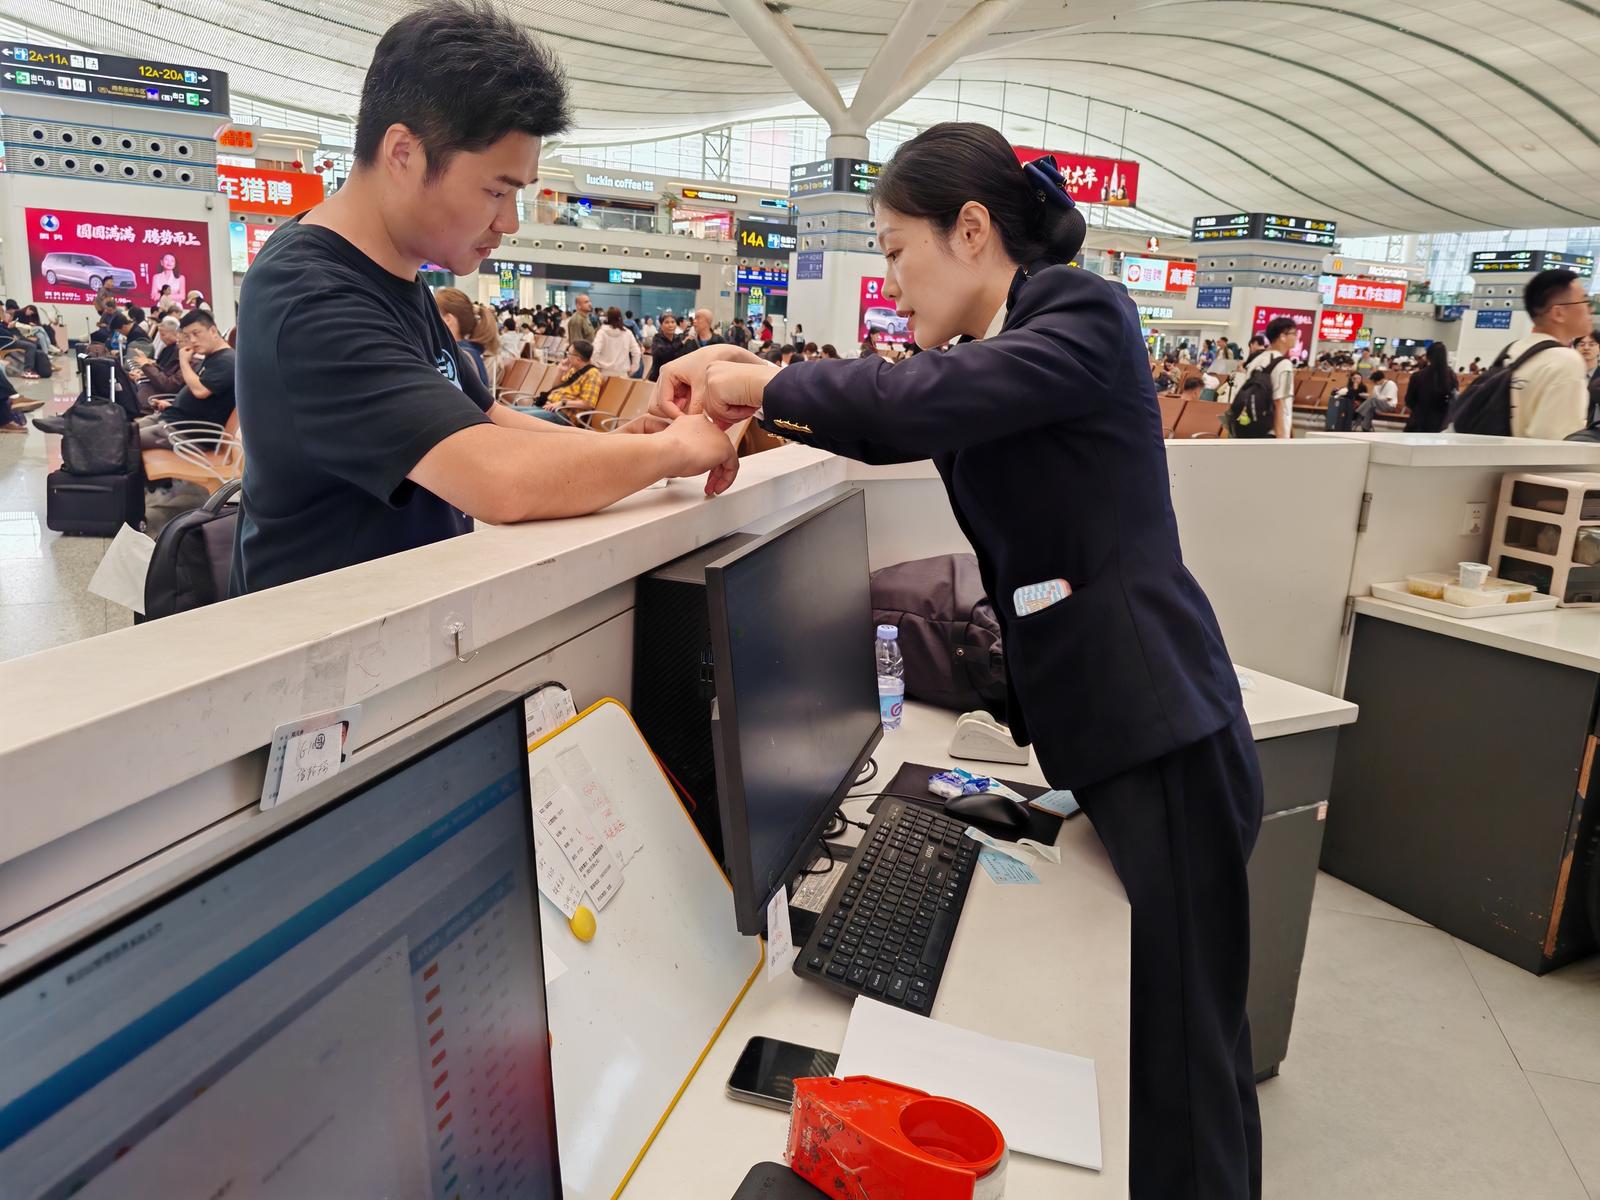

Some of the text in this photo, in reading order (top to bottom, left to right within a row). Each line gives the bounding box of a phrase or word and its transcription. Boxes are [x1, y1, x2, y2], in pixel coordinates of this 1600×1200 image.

[29, 50, 69, 66] 2A-11A
[139, 66, 184, 81] 12A-20A
[586, 173, 614, 187] luckin
[614, 179, 642, 190] coffee
[741, 231, 764, 247] 14A
